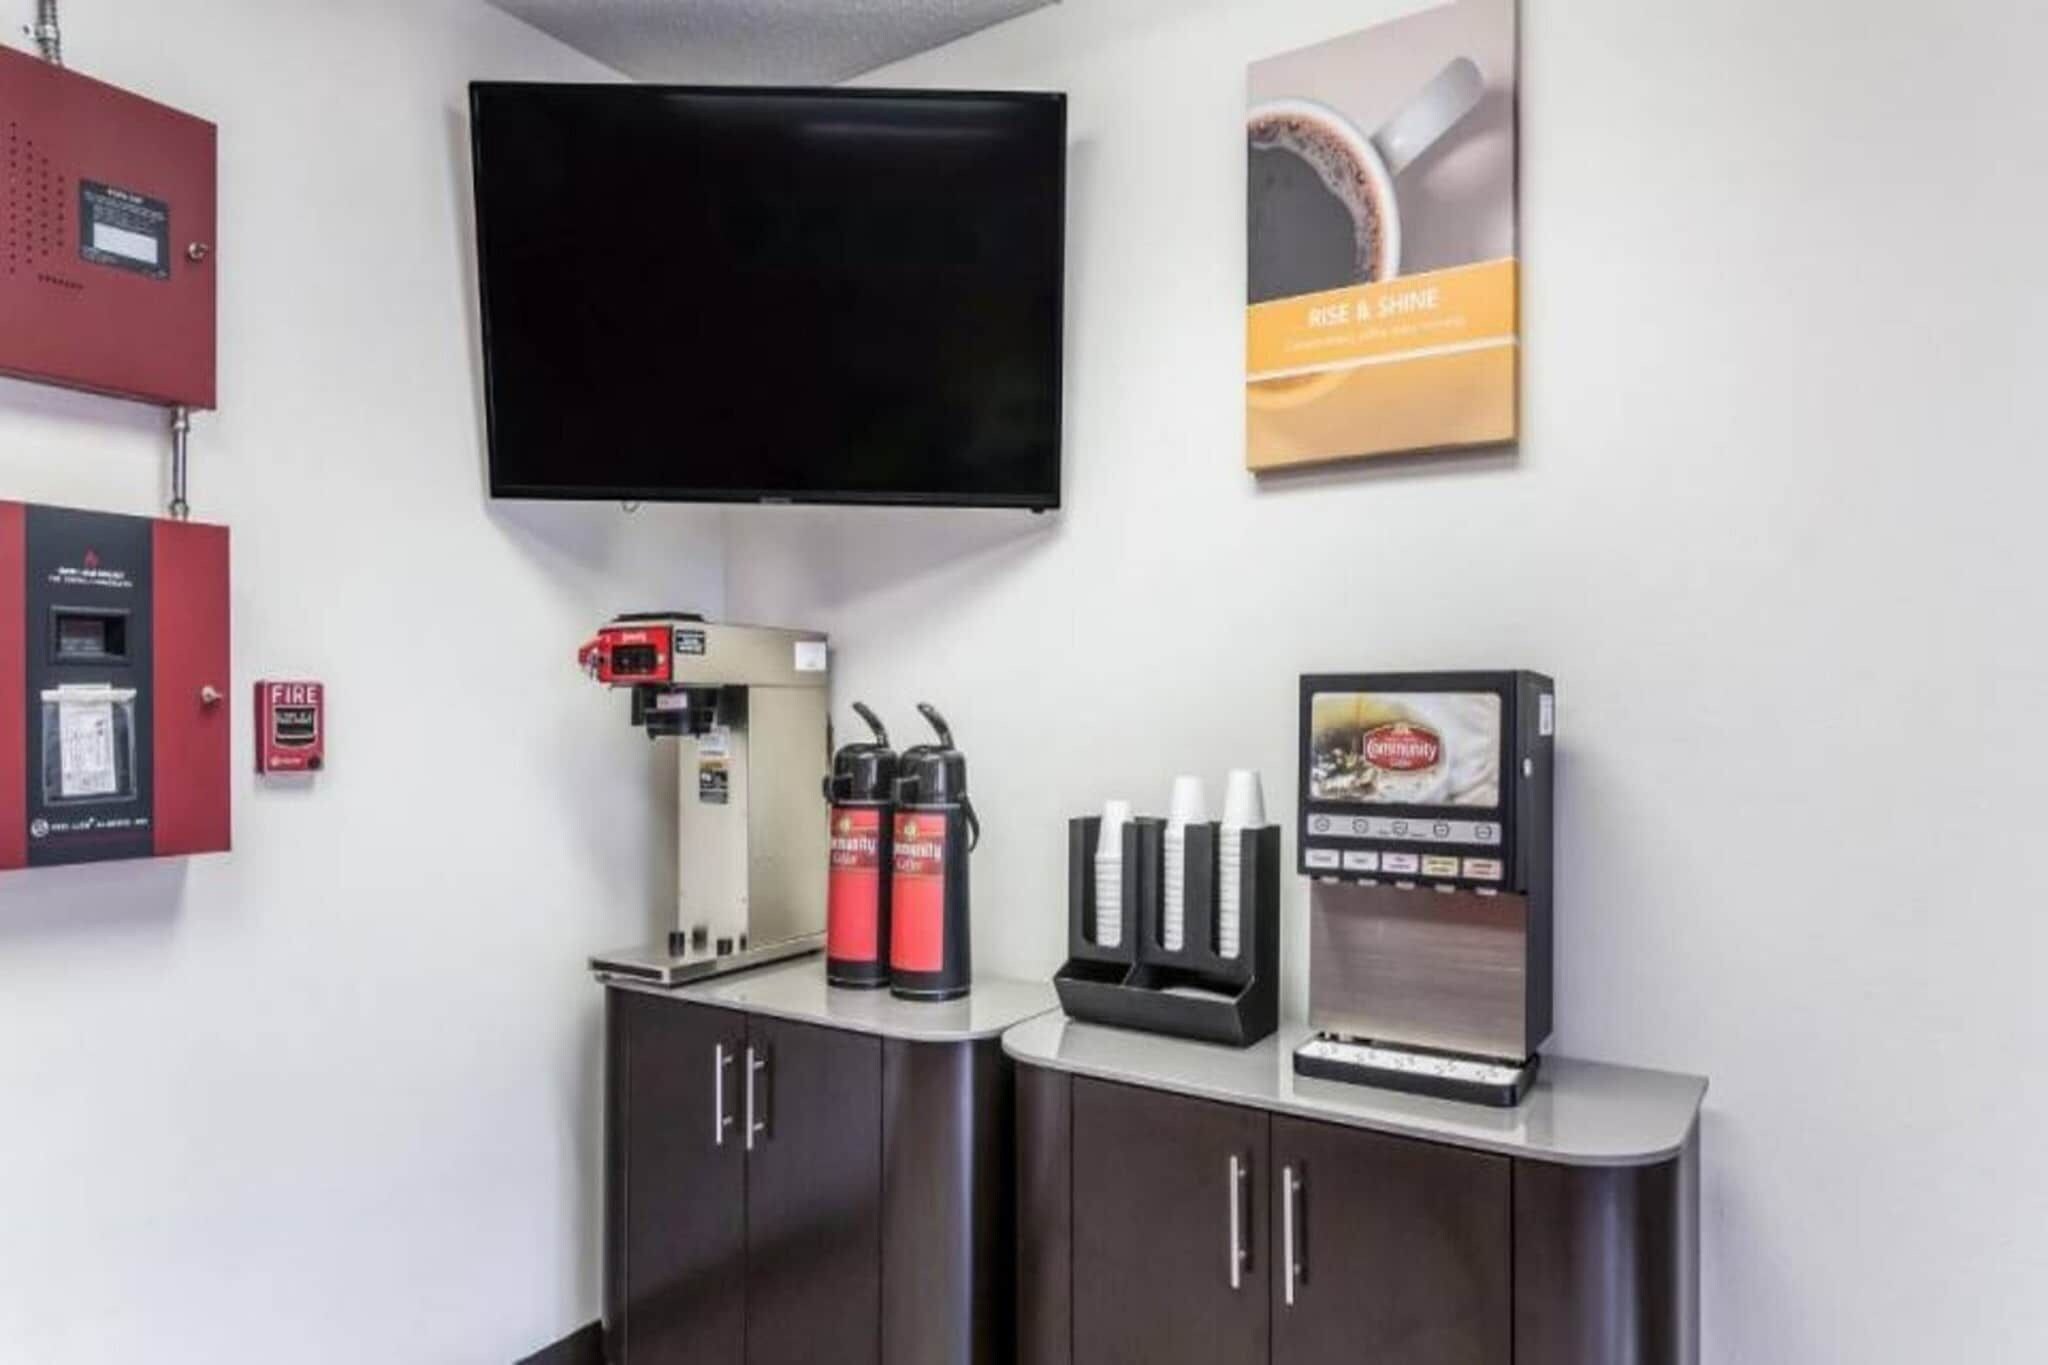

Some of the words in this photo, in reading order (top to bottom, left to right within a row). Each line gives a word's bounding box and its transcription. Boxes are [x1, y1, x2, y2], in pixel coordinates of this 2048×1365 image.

[1309, 303, 1349, 327] RISE
[1379, 288, 1438, 318] SHINE
[272, 685, 318, 704] FIRE
[1366, 739, 1437, 762] Community
